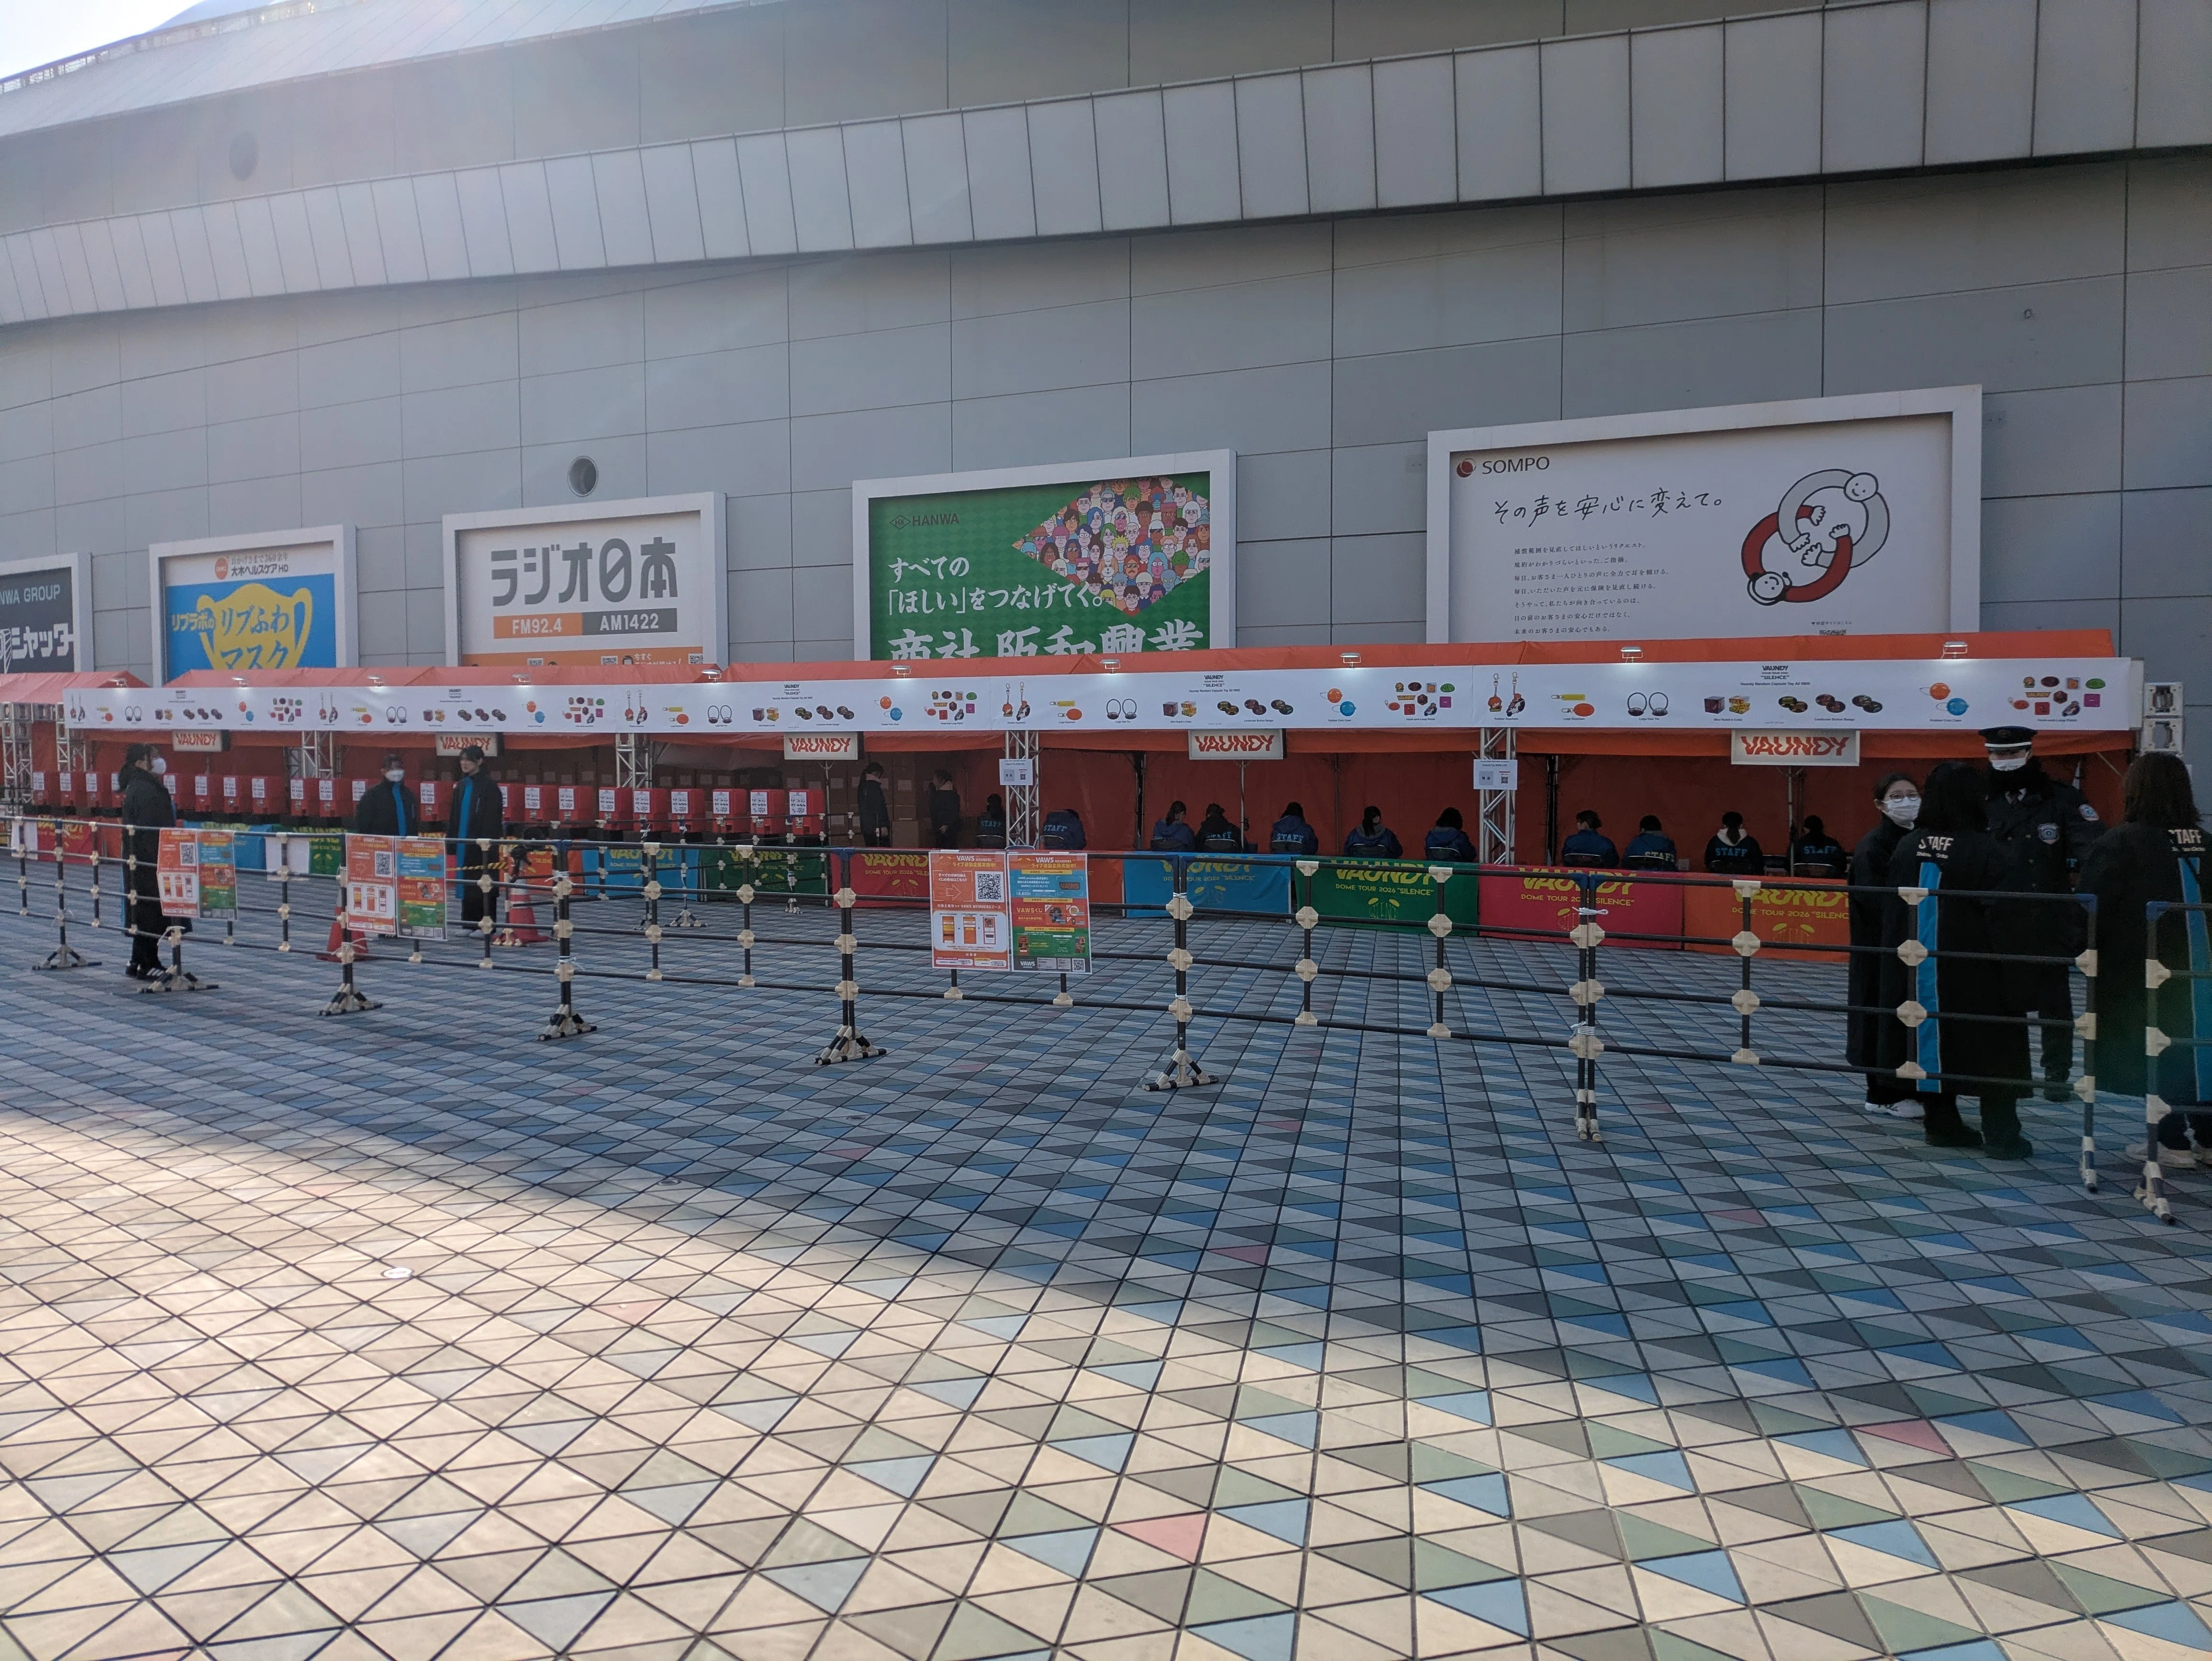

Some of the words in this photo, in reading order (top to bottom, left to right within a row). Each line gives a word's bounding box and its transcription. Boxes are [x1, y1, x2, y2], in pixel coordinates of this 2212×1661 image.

[1482, 456, 1550, 475] SOMPO
[1495, 487, 1722, 527] その声を安心に変えて。
[912, 513, 959, 527] HANWA
[491, 536, 678, 607] ラジオ日本
[888, 556, 970, 582] すべての
[24, 584, 60, 602] GROUP
[889, 584, 1104, 616] 「ほしい」をつなげてく。
[222, 604, 289, 635] リブふわ
[512, 618, 562, 634] FM92.4
[600, 613, 659, 631] AM1422
[221, 640, 289, 669] マスク
[176, 733, 217, 745] VAUNDY
[440, 737, 491, 751] VAUNDY
[788, 737, 851, 753] VAUNDY
[1195, 734, 1274, 753] VAUNDY
[1740, 736, 1850, 756] VAUNDY
[1276, 833, 1304, 842] STAFF
[2168, 829, 2202, 844] TAFF
[862, 854, 929, 867] VAUND
[1715, 848, 1748, 857] STAFF
[1160, 855, 1253, 873] VUNDY
[1331, 860, 1437, 885] VAUNDY
[1519, 867, 1637, 895] VAUDY
[1397, 887, 1434, 896] "SILENCE"
[1595, 897, 1635, 906] SILENCE"
